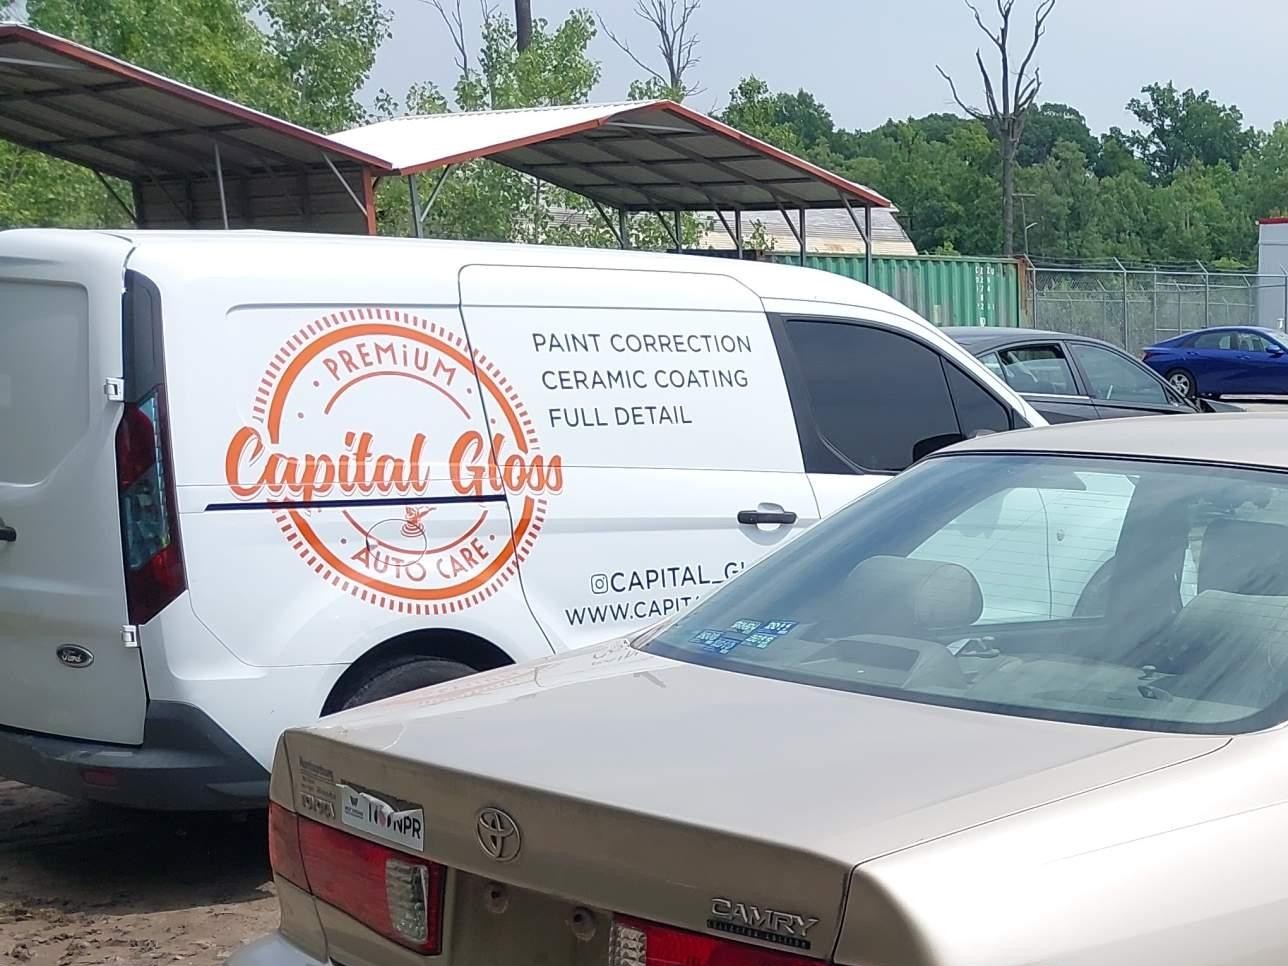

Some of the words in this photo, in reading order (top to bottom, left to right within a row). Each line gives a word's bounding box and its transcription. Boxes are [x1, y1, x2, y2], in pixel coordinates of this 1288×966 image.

[532, 333, 600, 352] PAINT
[610, 334, 752, 353] CORRECTION
[541, 370, 648, 390] CERAMIC
[654, 369, 749, 388] COATING
[549, 407, 609, 428] FULL
[614, 405, 693, 426] DETAIL
[225, 430, 431, 512] Capital
[449, 430, 563, 507] Gloss
[350, 545, 427, 582] AUTO
[436, 536, 490, 579] CARE
[565, 595, 700, 626] WWW.CAPIT
[710, 897, 819, 937] CAMRY
